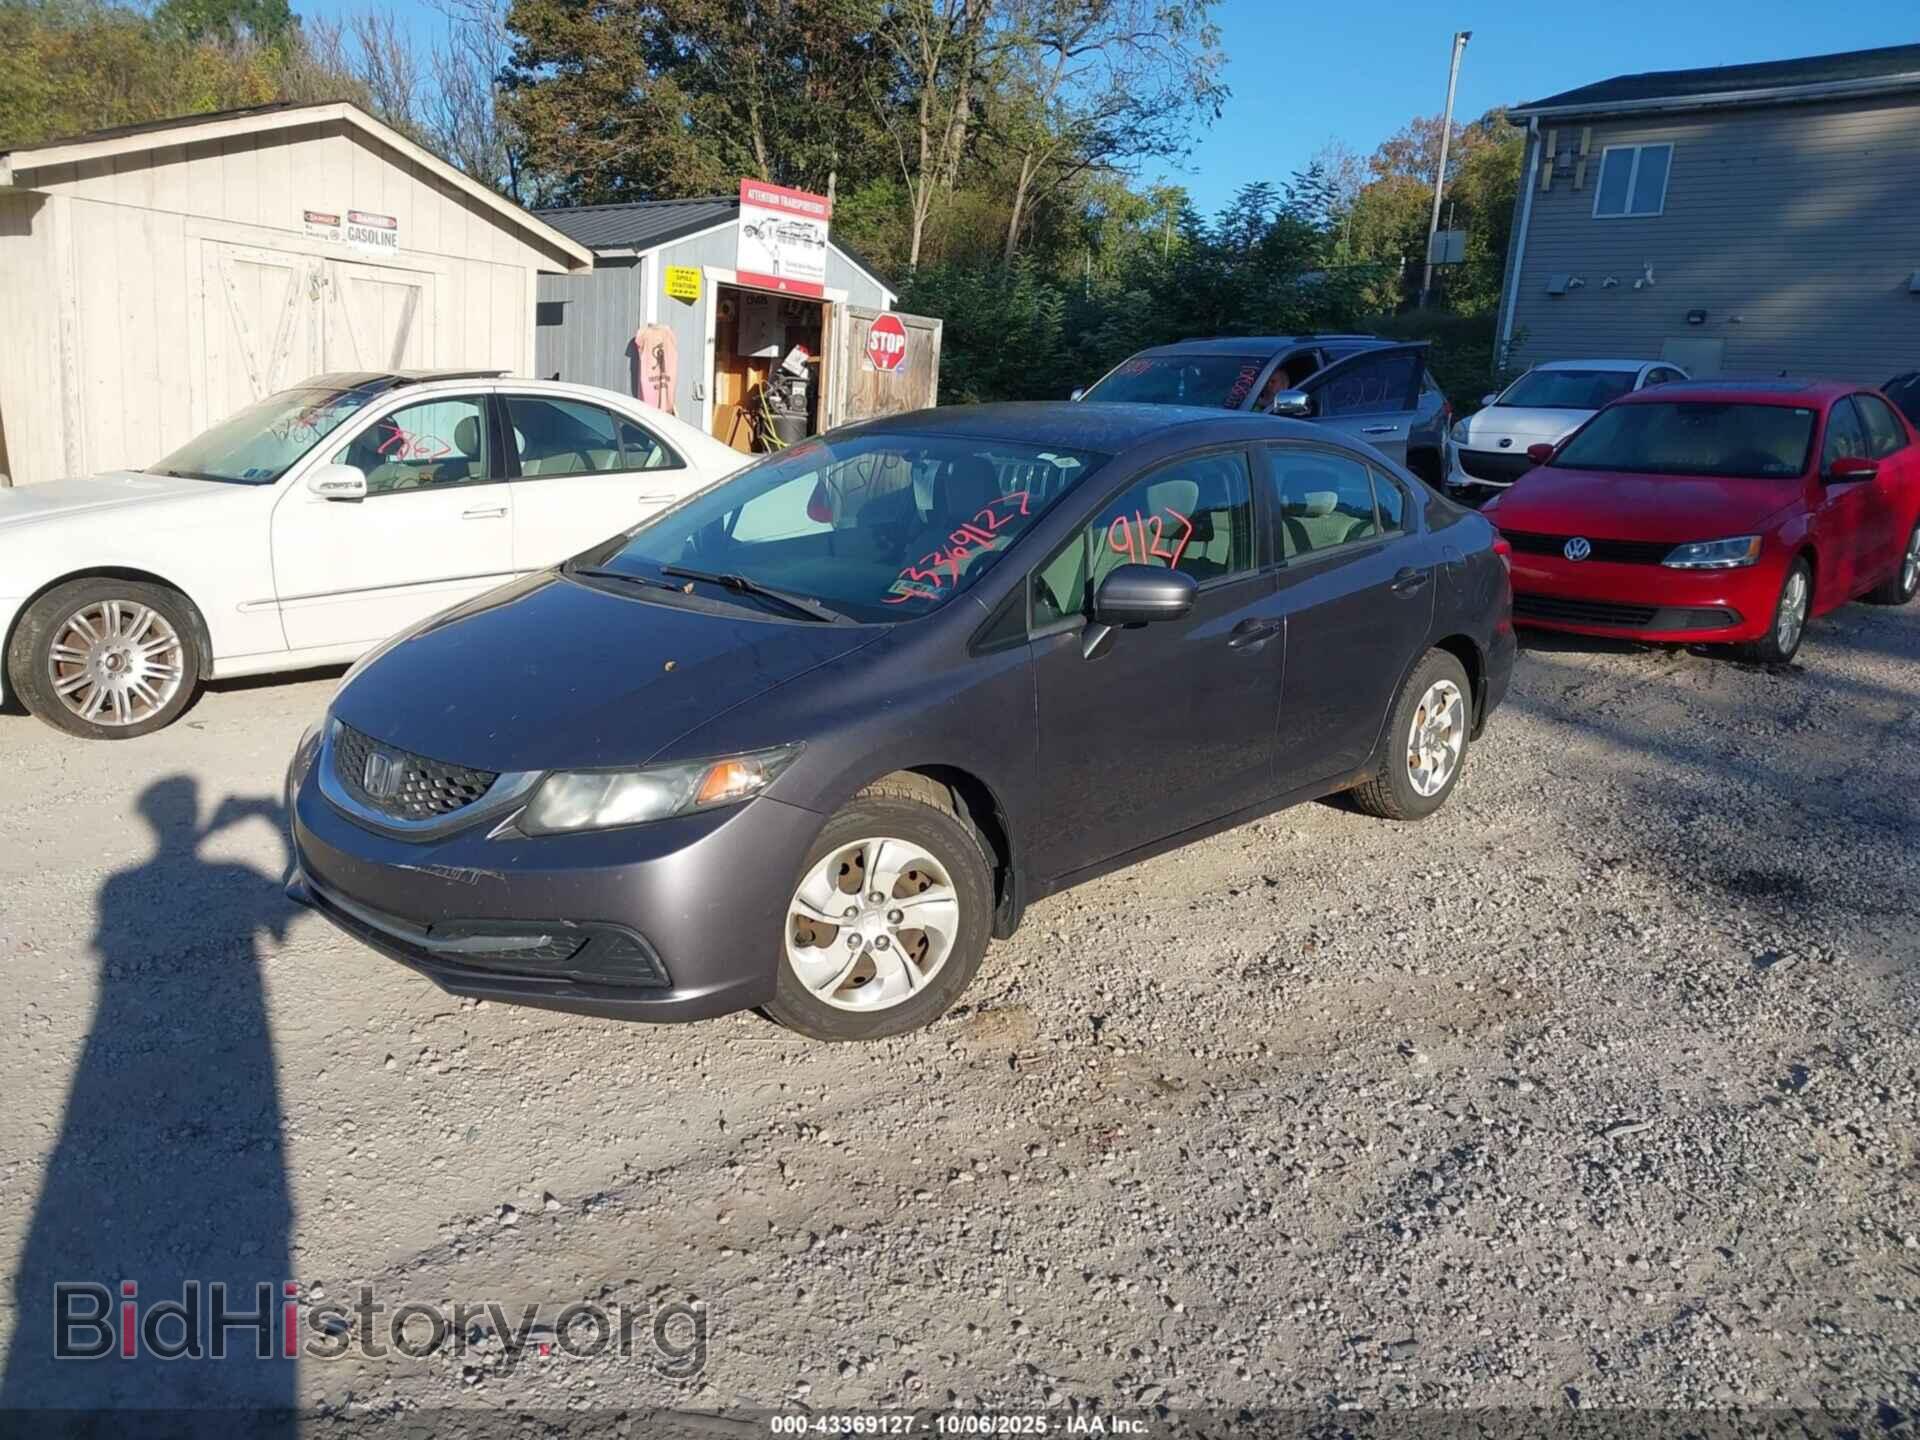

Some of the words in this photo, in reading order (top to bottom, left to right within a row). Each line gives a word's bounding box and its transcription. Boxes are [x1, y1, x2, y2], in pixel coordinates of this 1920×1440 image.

[347, 226, 397, 247] GASOLINE
[870, 330, 905, 354] STOP
[1108, 507, 1193, 570] 9127
